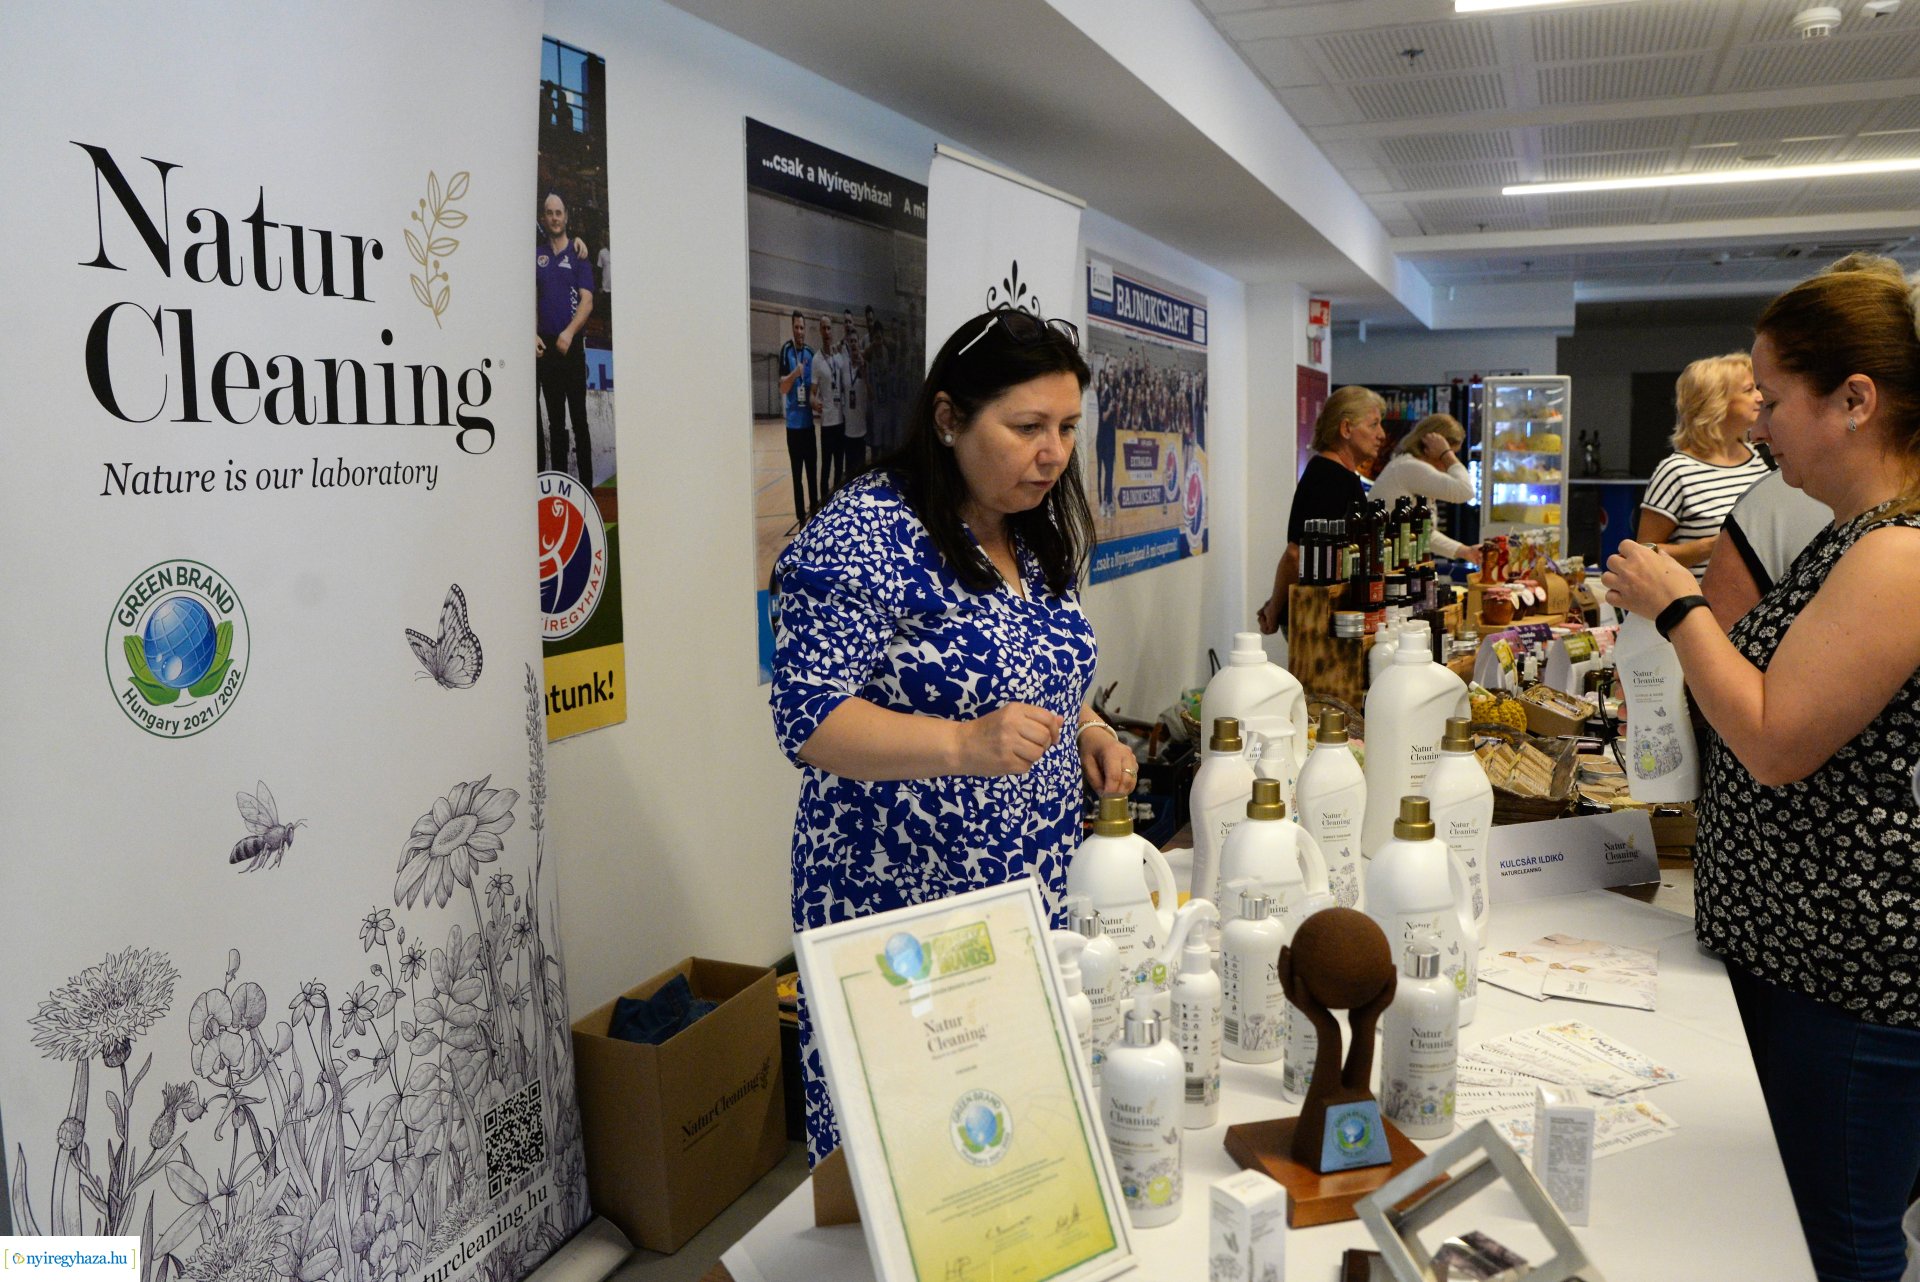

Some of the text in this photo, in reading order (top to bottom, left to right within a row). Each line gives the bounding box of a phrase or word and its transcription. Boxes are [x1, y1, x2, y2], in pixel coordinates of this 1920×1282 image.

[762, 154, 926, 220] ...csak a Nyíregyháza! A mi
[69, 140, 384, 303] Natur
[1116, 283, 1190, 335] BAJNOKCSAPAT
[85, 301, 496, 455] Cleaning
[100, 456, 439, 497] Nature is our laboratory
[117, 566, 235, 628] GREEN BRAND
[541, 548, 603, 632] ÍREGYHÁZA
[122, 687, 180, 735] Hungary
[1410, 751, 1441, 761] Cleanin
[1411, 744, 1433, 753] Natur
[1321, 818, 1351, 827] Cleaning
[1322, 812, 1342, 820] Natur
[1449, 828, 1479, 836] Cleaning
[1604, 841, 1627, 852] Natur
[1500, 851, 1565, 869] KULCSÁR ILDIKÓ
[1605, 849, 1639, 862] Cleaning
[1501, 866, 1542, 877] NATURCLEANING
[1269, 904, 1289, 915] ning
[1102, 924, 1136, 936] leaning
[1089, 993, 1116, 1006] aning
[923, 1016, 964, 1037] Natur
[1411, 1027, 1442, 1039] Natur
[927, 1024, 988, 1053] Cleaning
[1410, 1038, 1454, 1050] Cleaning
[1111, 1097, 1143, 1115] Natur
[1110, 1110, 1161, 1128] Cleaning
